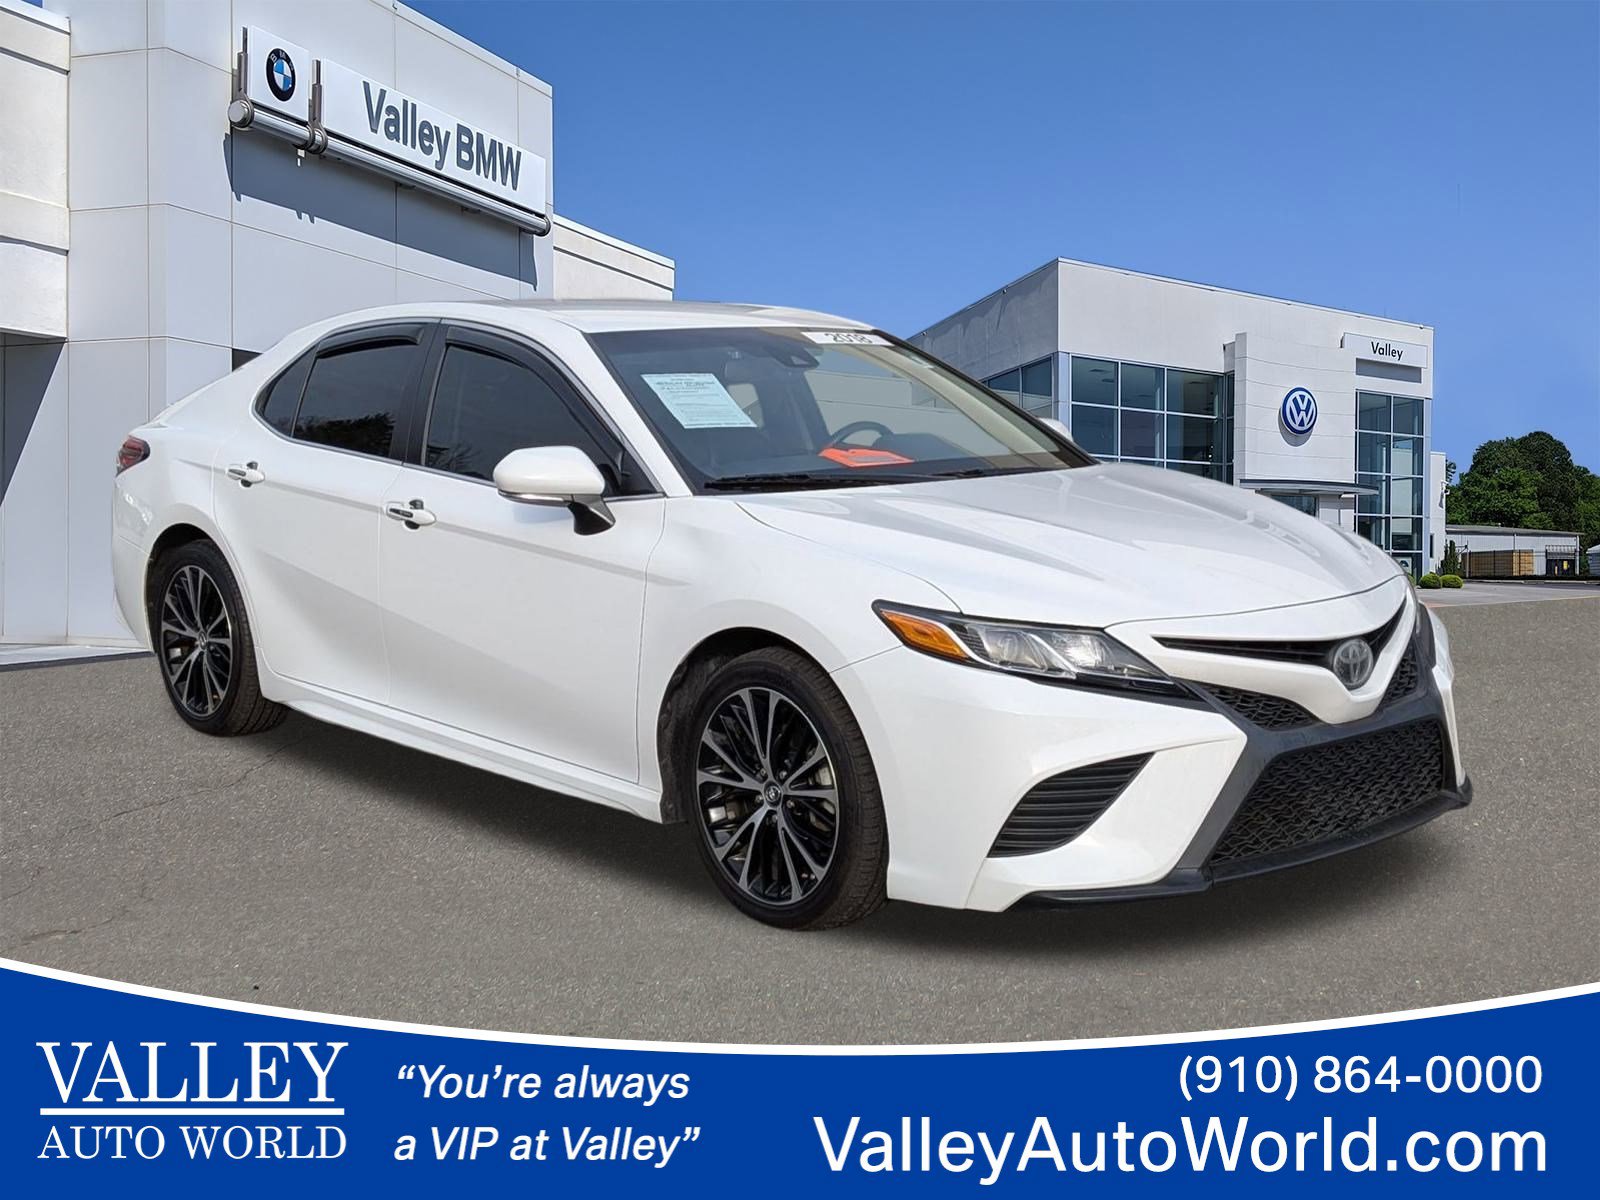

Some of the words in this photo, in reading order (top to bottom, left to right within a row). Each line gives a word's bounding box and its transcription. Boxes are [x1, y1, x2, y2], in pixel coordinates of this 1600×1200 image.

[362, 81, 450, 171] Valley
[456, 123, 522, 191] BMW
[824, 333, 873, 344] 2018
[1371, 341, 1403, 361] Valley
